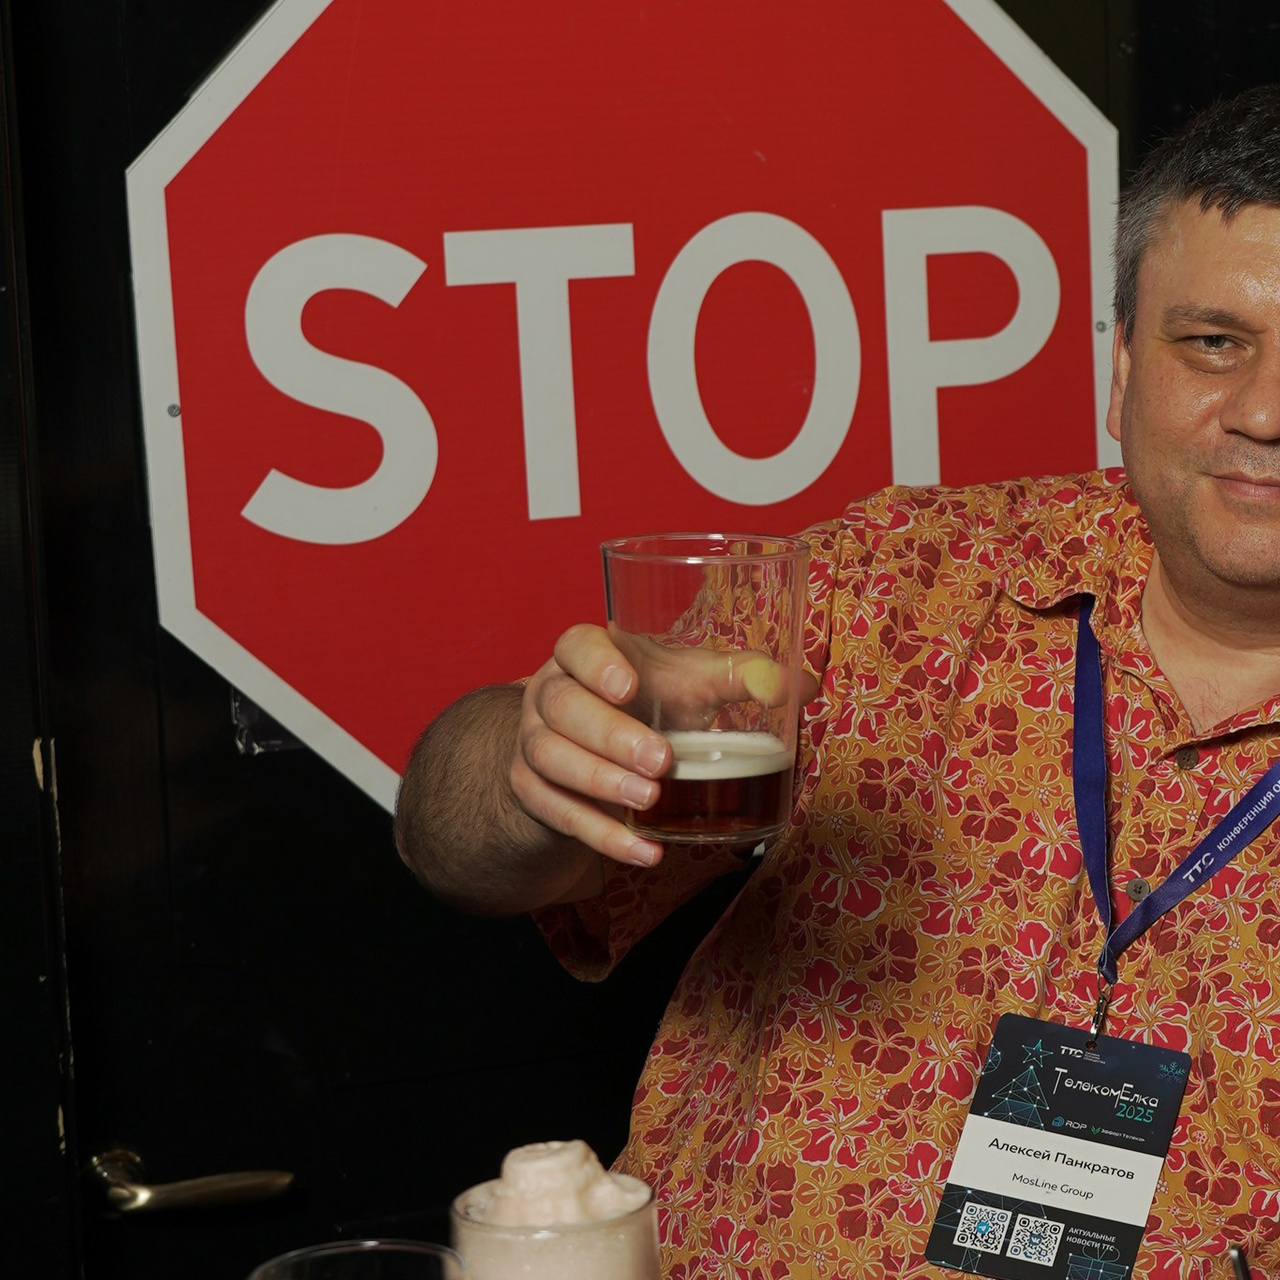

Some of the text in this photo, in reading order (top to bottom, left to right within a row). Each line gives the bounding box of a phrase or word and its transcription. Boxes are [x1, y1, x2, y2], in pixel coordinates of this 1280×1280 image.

[241, 205, 1060, 545] STOP
[1216, 792, 1275, 852] КОНФЕРЕНЦИЯ
[1065, 1119, 1087, 1131] RDP
[1115, 1102, 1155, 1124] 2025
[988, 1136, 1135, 1181] Алексей Панкратов
[1012, 1172, 1094, 1201] MosLine Group
[1066, 1234, 1101, 1249] НОВОСТИ
[1068, 1226, 1116, 1243] АКТУАЛЬНЫЕ
